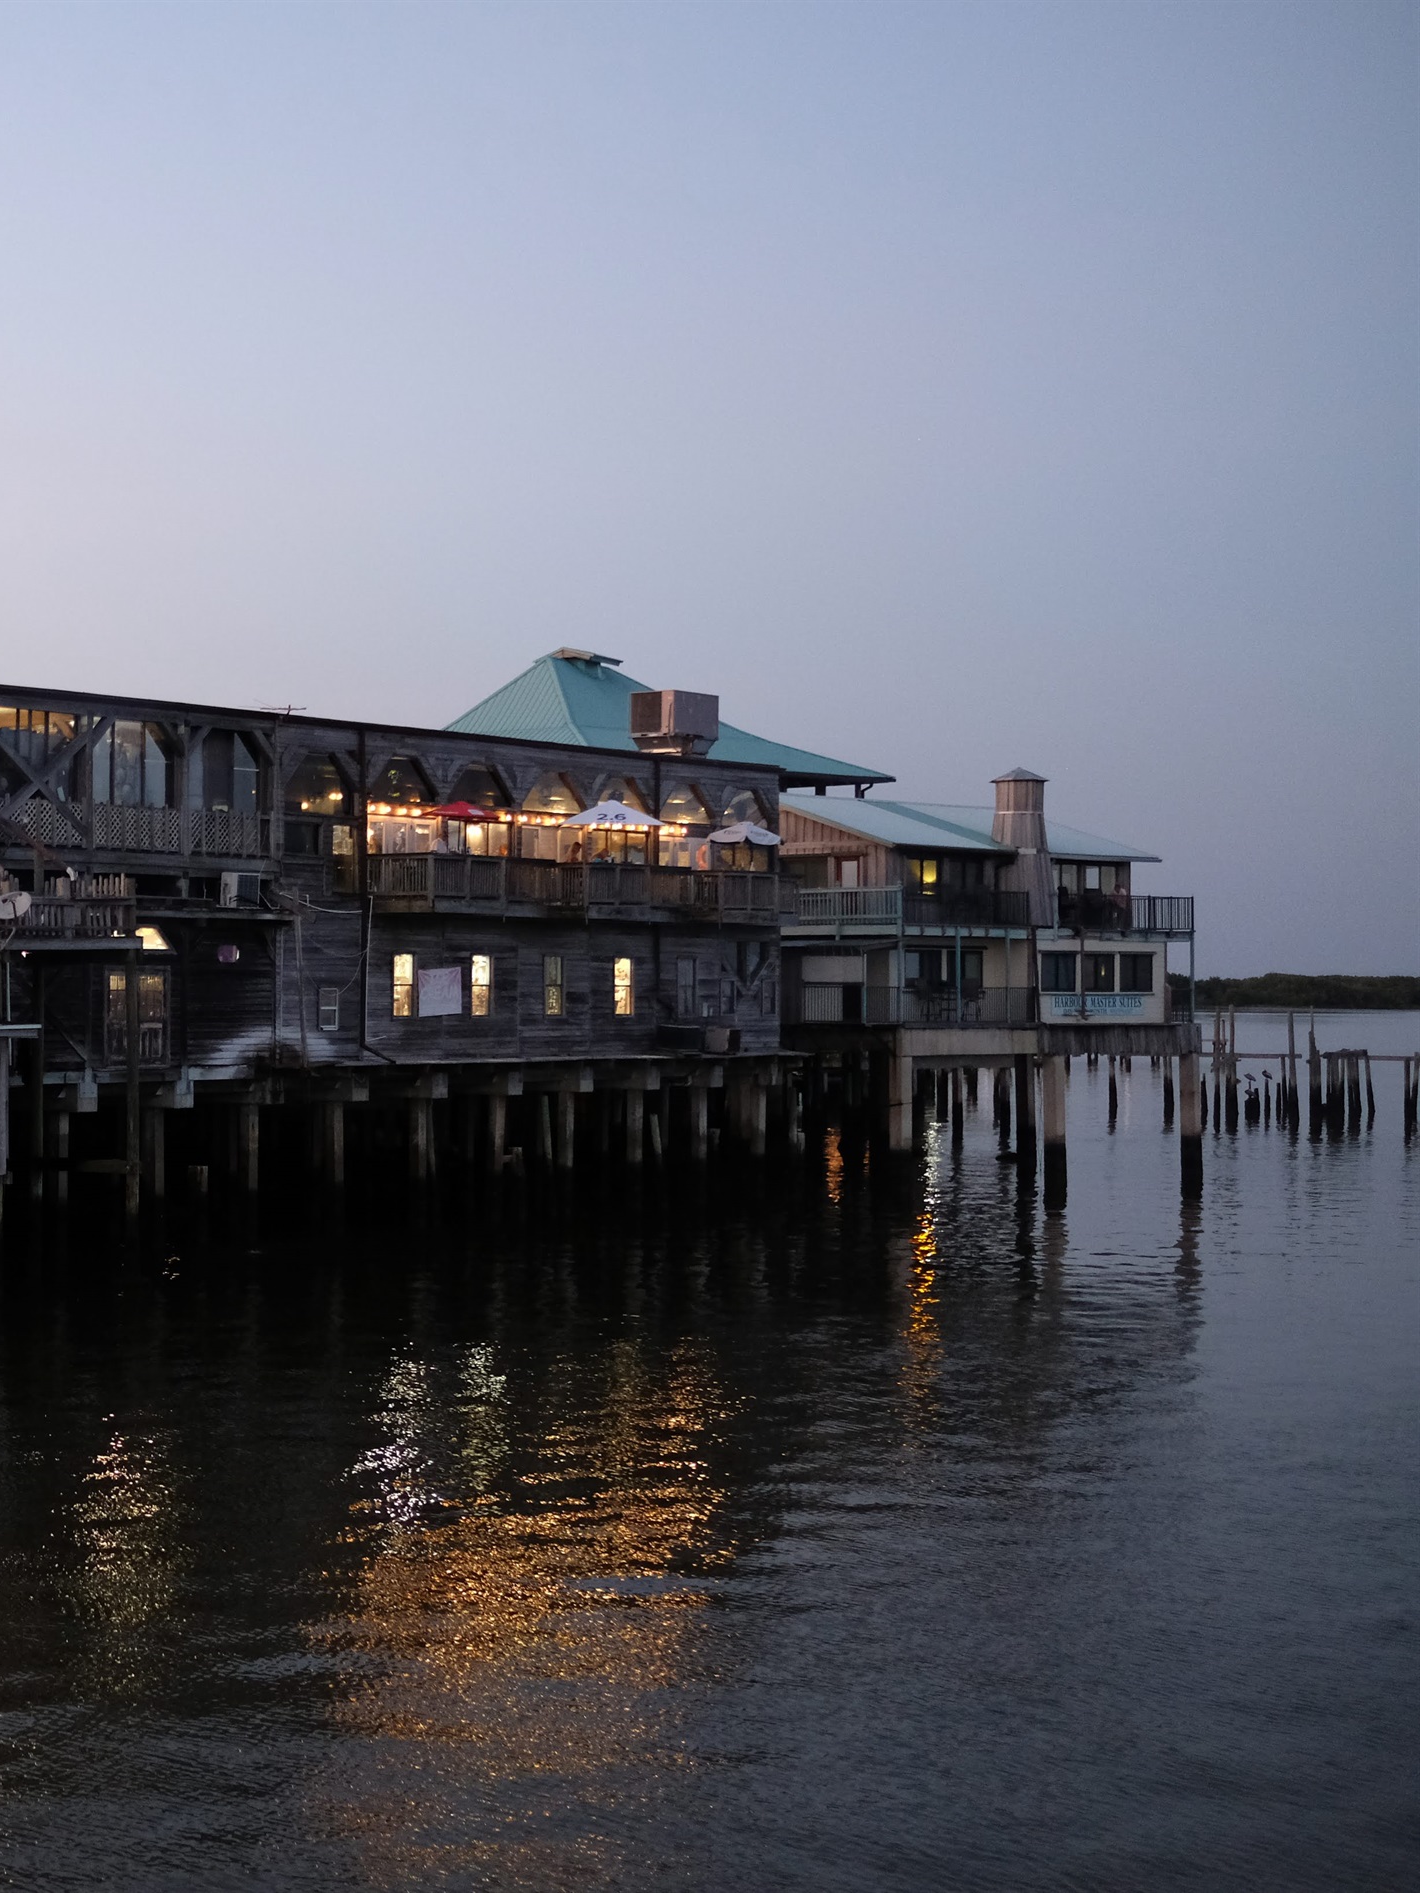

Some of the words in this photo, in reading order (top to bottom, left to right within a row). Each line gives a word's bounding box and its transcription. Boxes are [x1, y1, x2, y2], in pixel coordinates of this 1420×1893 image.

[596, 813, 627, 821] 2.6
[1090, 996, 1117, 1008] MASTER
[1118, 996, 1142, 1008] SUITES
